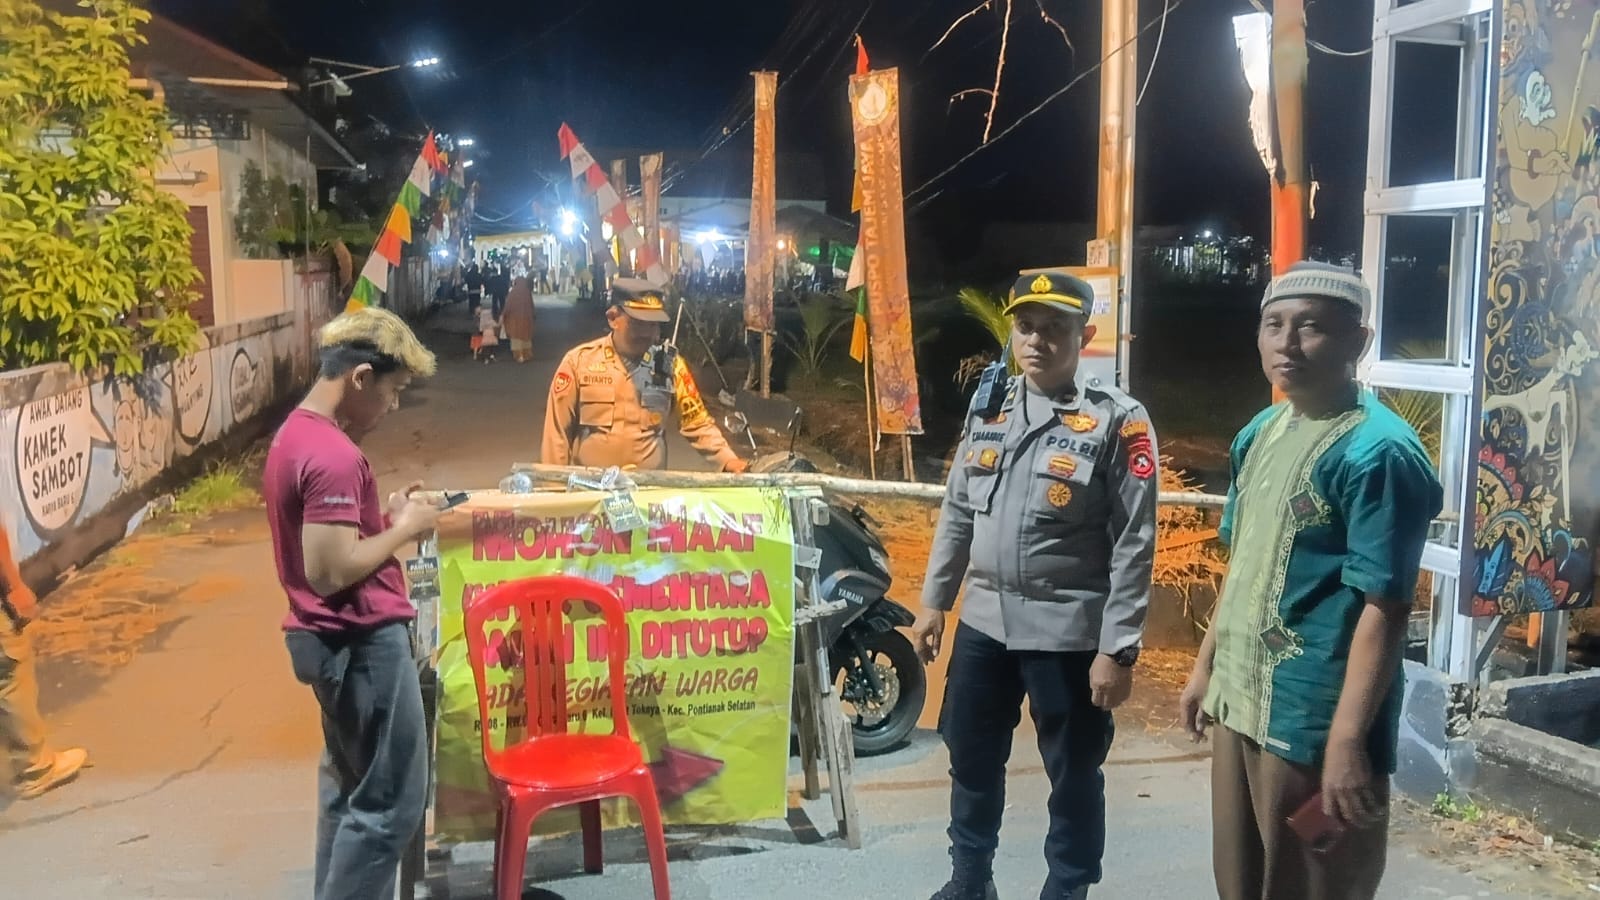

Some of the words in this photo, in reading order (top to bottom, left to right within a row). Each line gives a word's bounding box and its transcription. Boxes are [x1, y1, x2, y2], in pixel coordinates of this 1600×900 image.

[30, 398, 52, 424] AWAK
[55, 390, 82, 416] DATANG
[24, 424, 67, 470] KAMEK
[32, 452, 83, 499] SAMBOT
[472, 511, 632, 561] MOHON
[647, 503, 764, 553] MAAF
[838, 587, 864, 605] YAMAHA
[641, 616, 769, 660] DITUTUP
[675, 666, 759, 698] WARGA
[687, 701, 726, 716] Pontianak
[727, 700, 756, 712] Selatan
